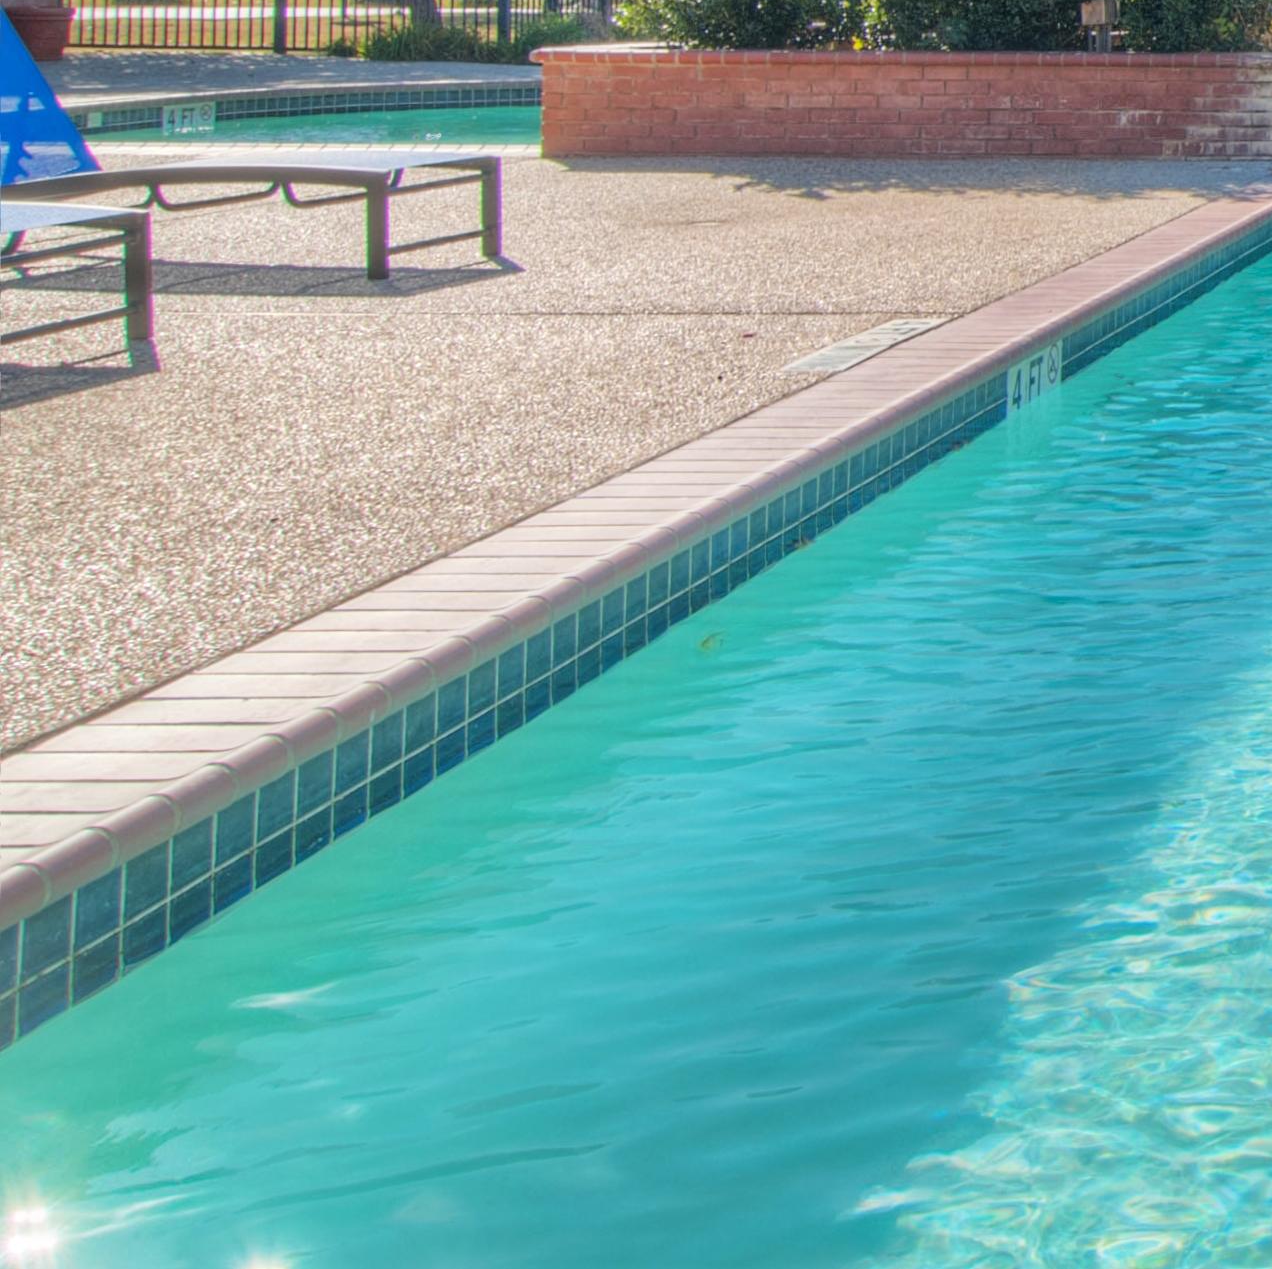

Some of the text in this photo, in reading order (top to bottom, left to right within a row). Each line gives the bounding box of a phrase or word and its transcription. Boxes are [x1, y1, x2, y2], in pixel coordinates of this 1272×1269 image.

[167, 107, 195, 128] 4 FT
[1011, 354, 1044, 410] 4 FT
